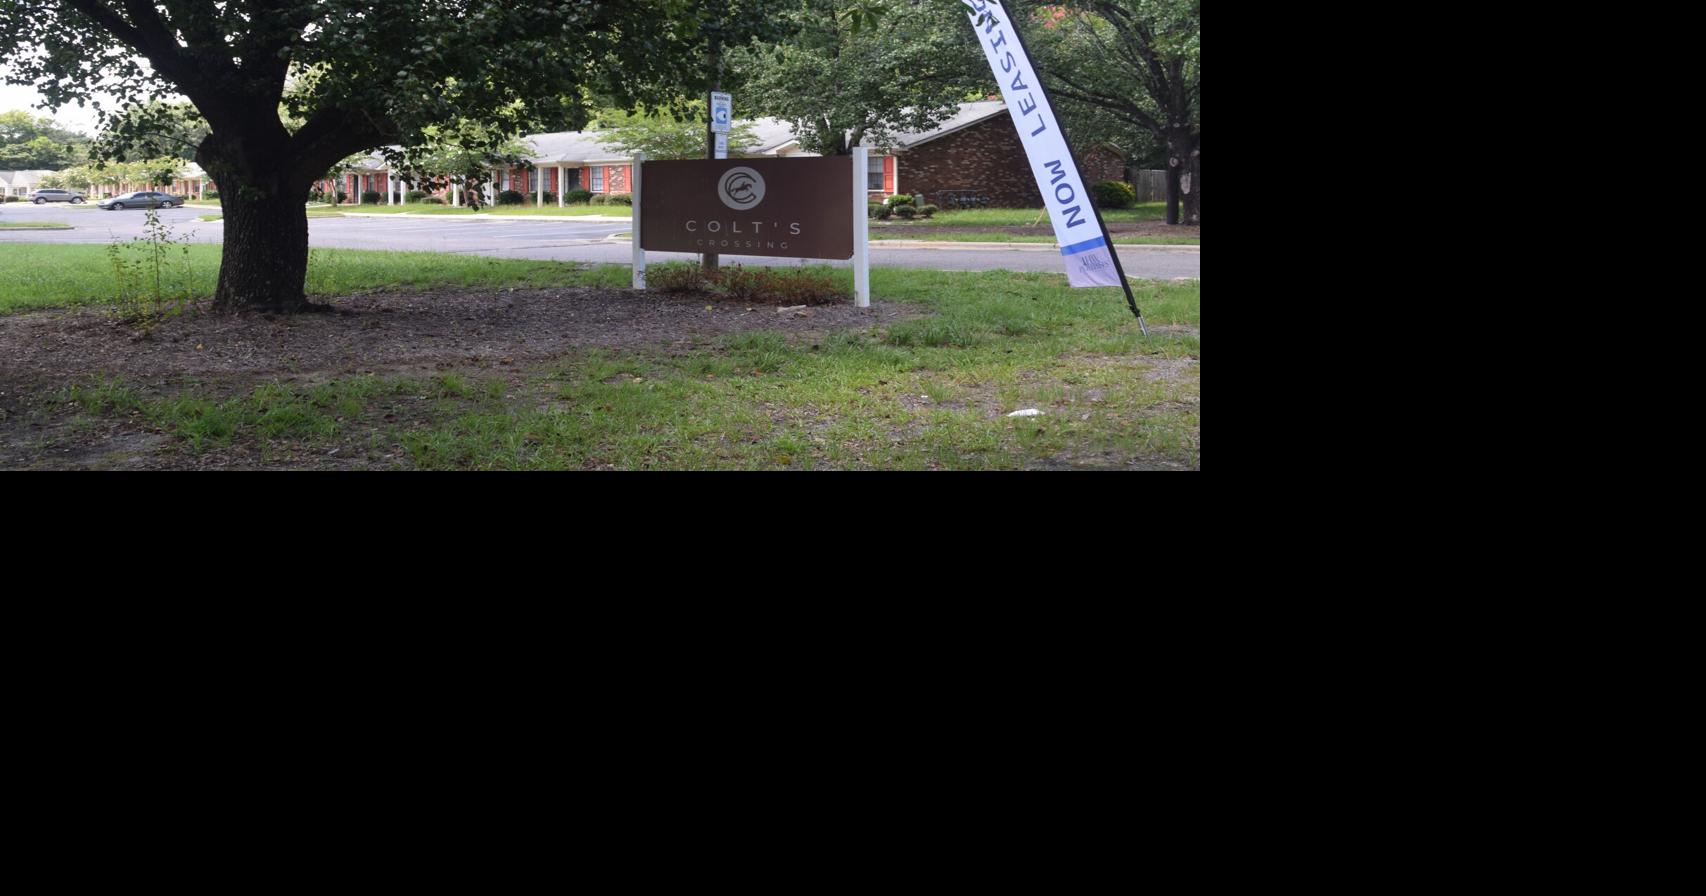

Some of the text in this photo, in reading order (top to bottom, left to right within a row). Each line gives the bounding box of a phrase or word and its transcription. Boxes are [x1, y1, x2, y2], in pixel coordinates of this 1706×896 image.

[1044, 159, 1087, 229] NOW
[686, 220, 801, 236] COLT'S
[696, 239, 789, 250] CROSSING
